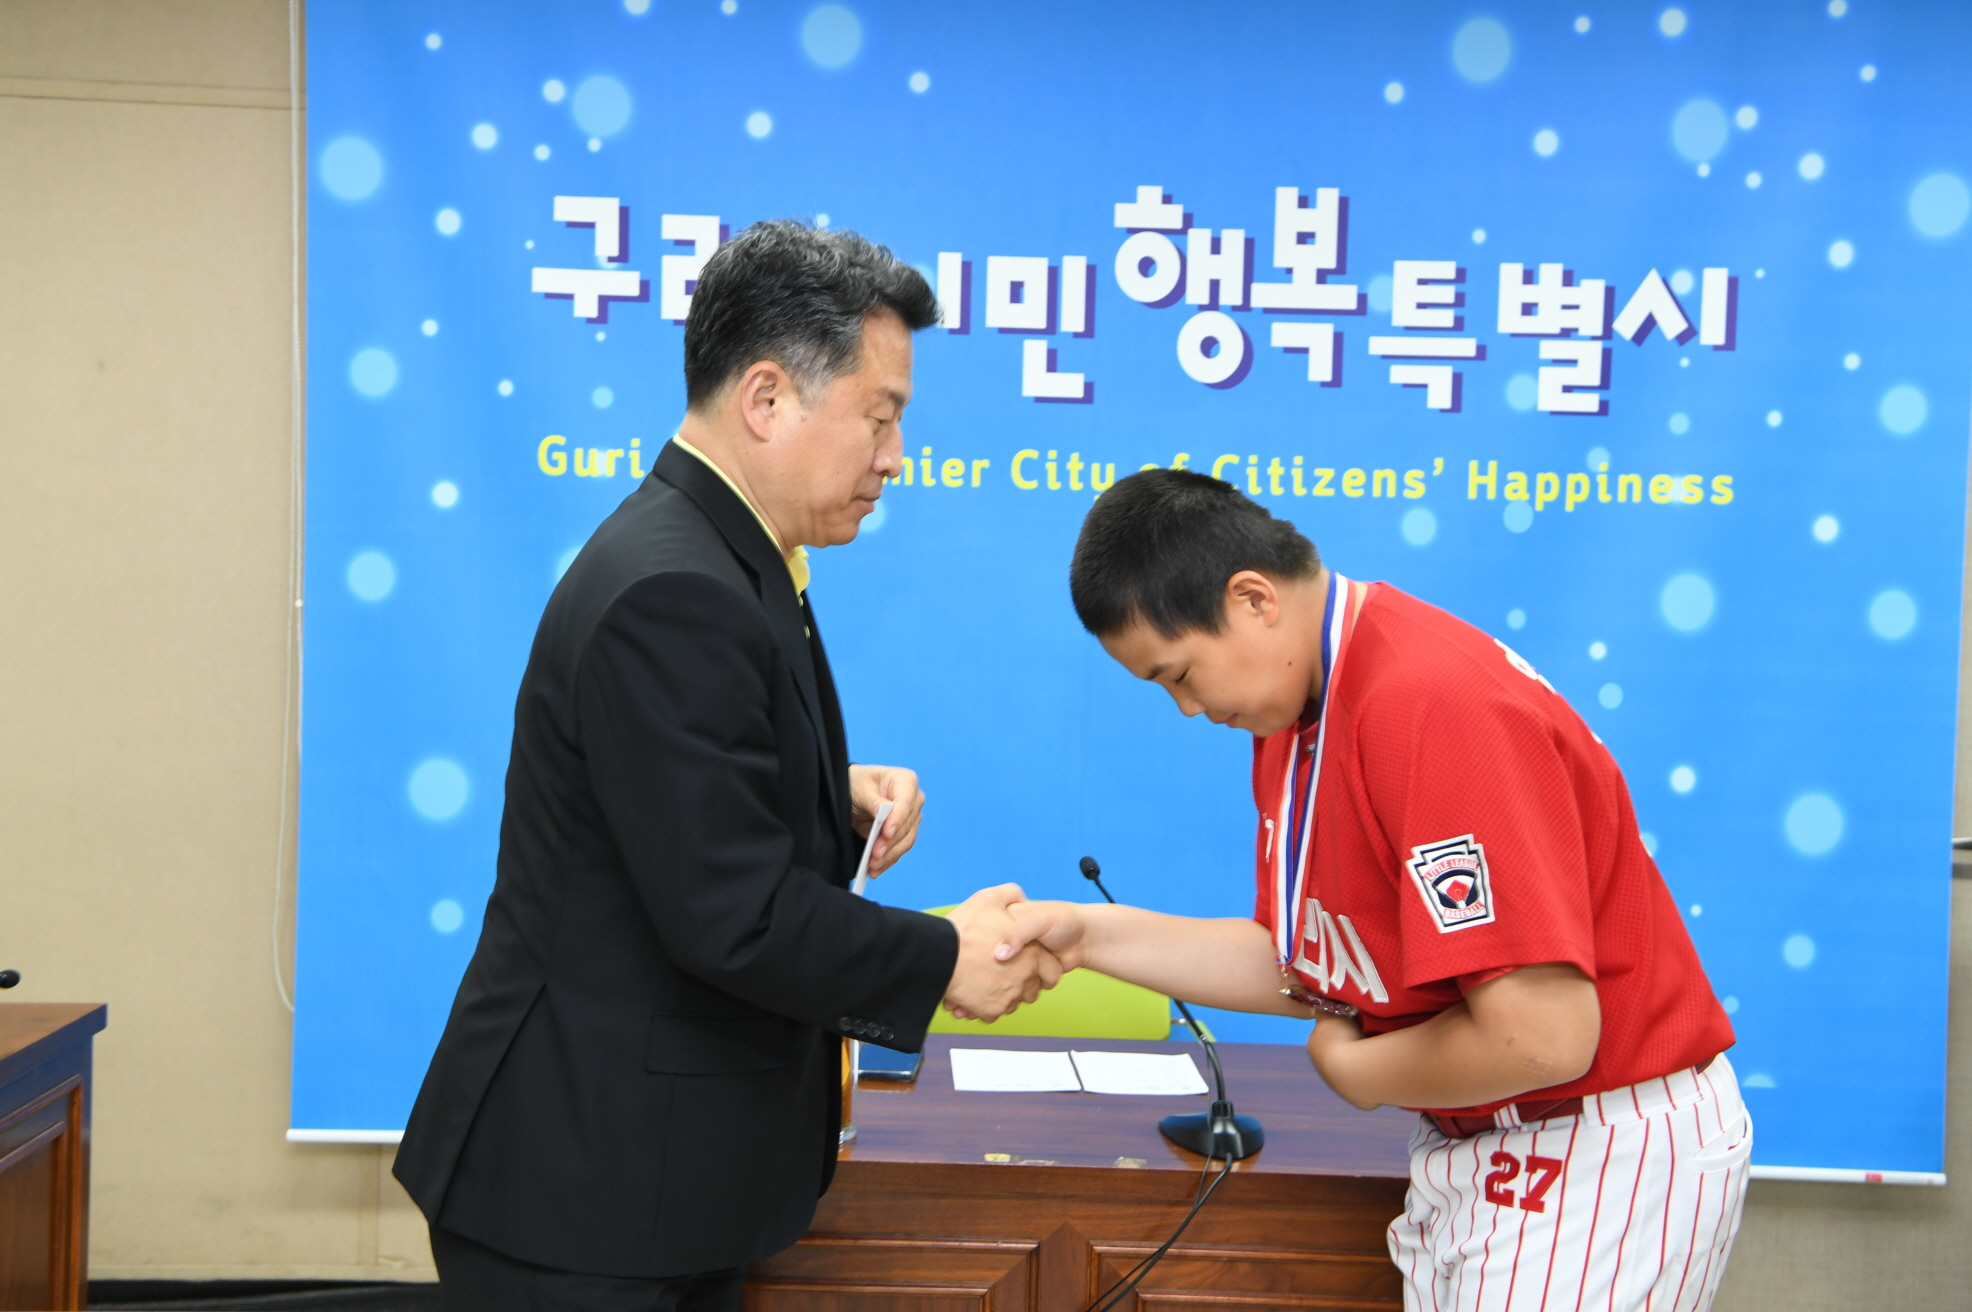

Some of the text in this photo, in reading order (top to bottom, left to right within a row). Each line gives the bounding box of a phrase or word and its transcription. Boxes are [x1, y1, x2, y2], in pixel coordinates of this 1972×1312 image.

[537, 434, 645, 479] Guri
[1010, 448, 1116, 501] City
[1467, 460, 1735, 512] Happiness
[1424, 858, 1480, 882] LITTLE LEAGUE
[1443, 902, 1484, 919] BASEBALL
[1484, 1150, 1563, 1213] 27
